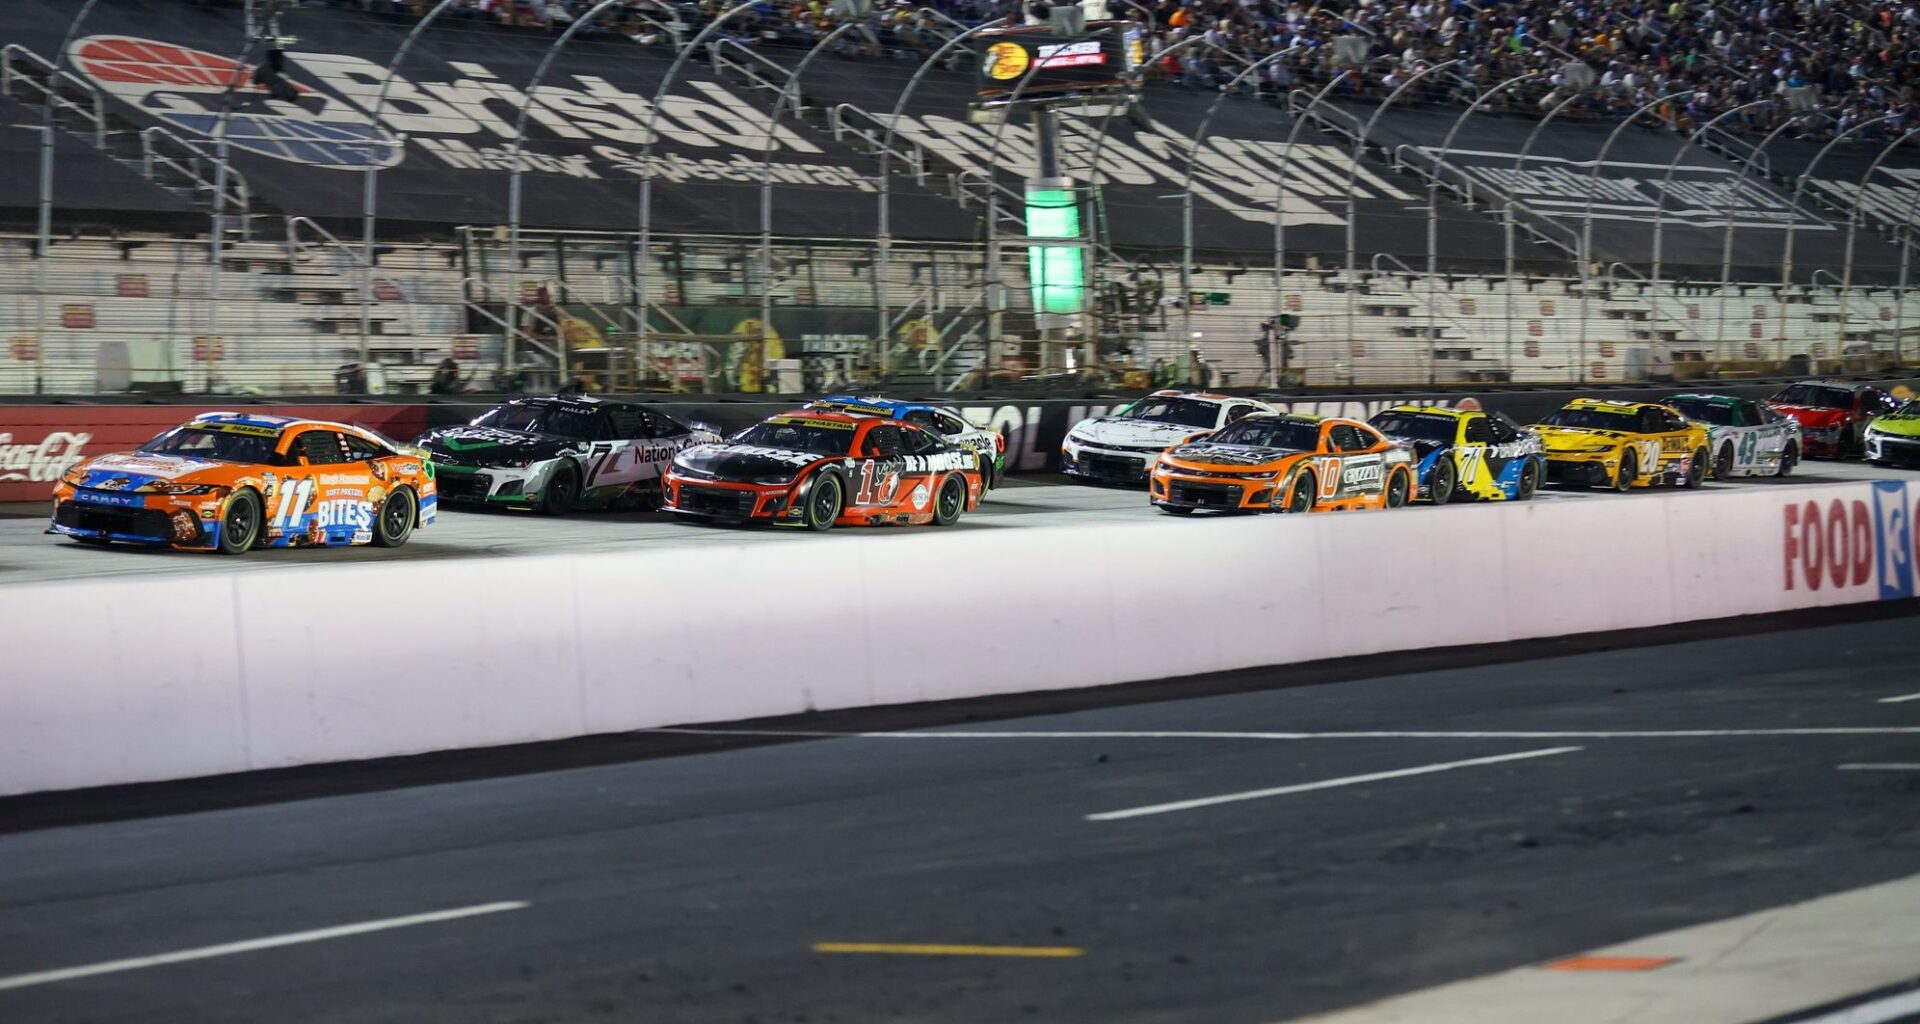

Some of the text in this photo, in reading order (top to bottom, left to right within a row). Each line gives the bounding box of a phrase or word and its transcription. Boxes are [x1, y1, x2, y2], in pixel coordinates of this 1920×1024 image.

[285, 52, 824, 153] Bristol
[411, 137, 878, 192] Motor Speedway
[1208, 136, 1416, 200] CITY
[560, 406, 591, 415] HALEY
[807, 419, 853, 429] CHASTAIN
[231, 425, 276, 435] HAMLIN
[1738, 431, 1757, 465] 43
[584, 442, 614, 488] 7
[1343, 465, 1380, 484] GRIZZLY
[1459, 446, 1483, 485] 71
[1640, 441, 1660, 473] 20
[1319, 457, 1341, 498] 10
[81, 494, 131, 505] CAMRY
[273, 479, 313, 527] 11
[318, 499, 373, 531] BITES
[1784, 499, 1872, 591] FOOD
